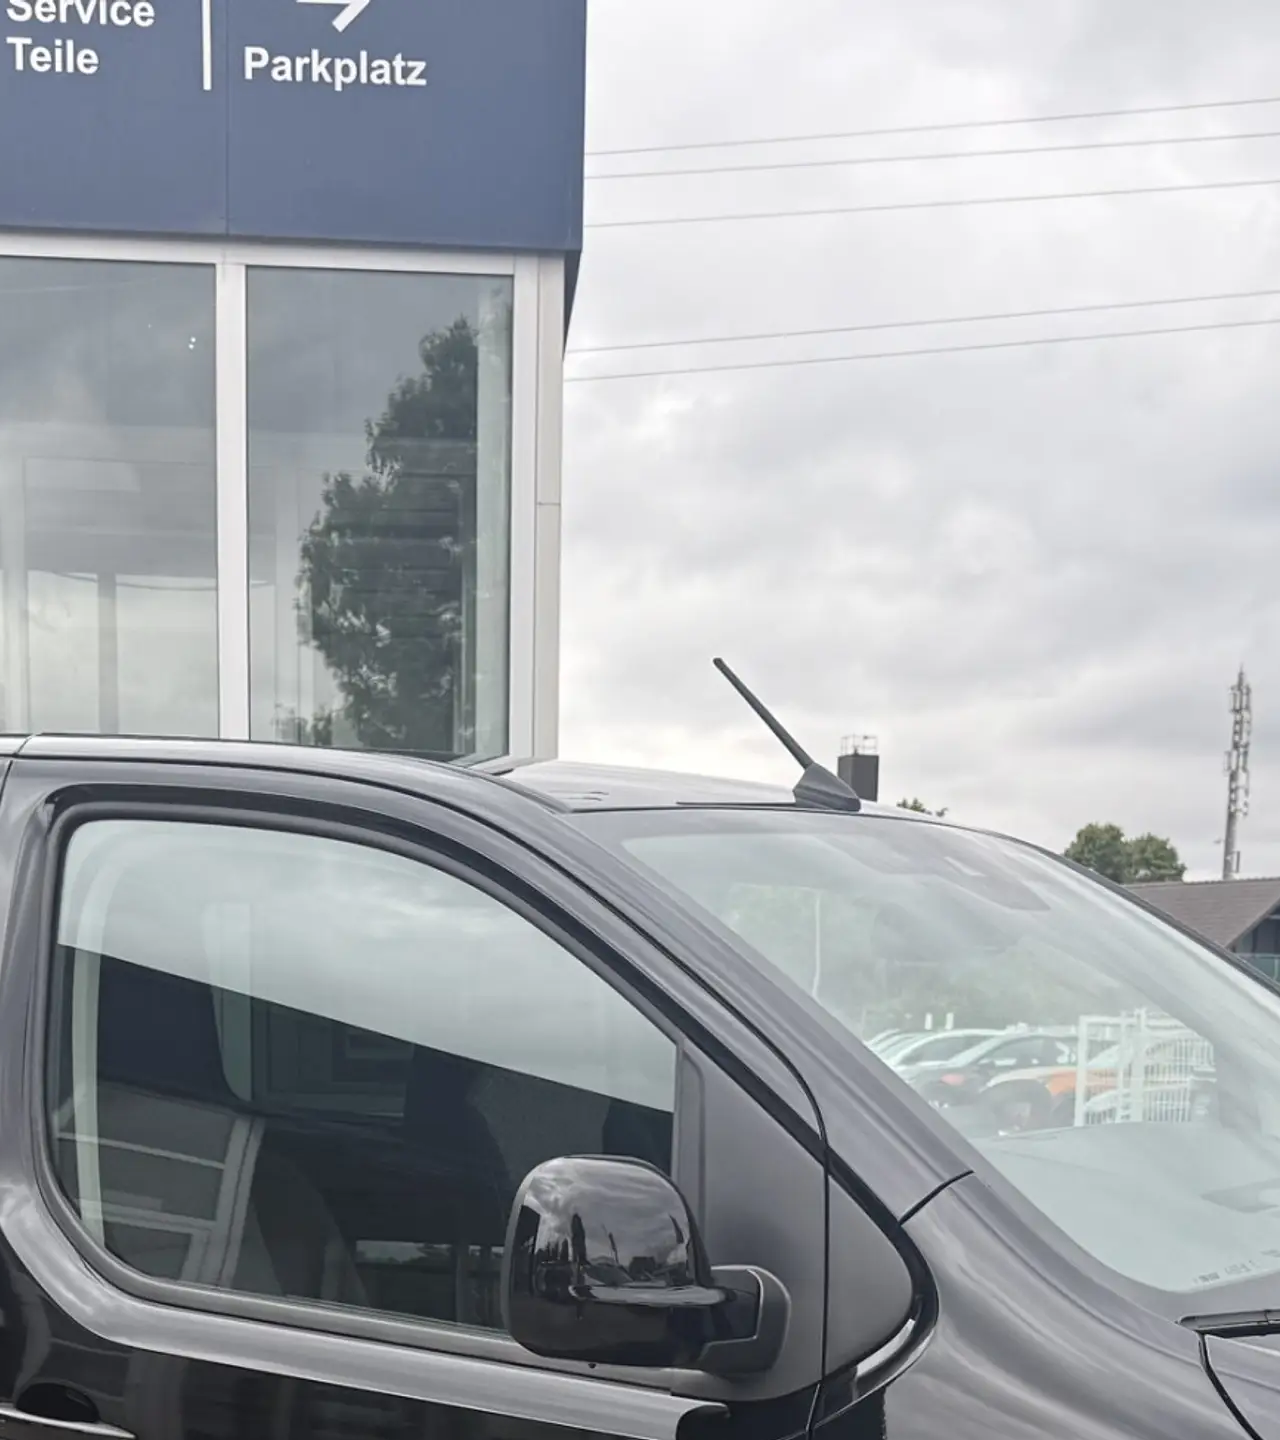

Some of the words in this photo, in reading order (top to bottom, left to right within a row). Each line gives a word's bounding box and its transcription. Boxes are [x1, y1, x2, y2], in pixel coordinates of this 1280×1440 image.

[6, 0, 156, 27] Service
[6, 36, 100, 74] Teile
[243, 45, 428, 92] Parkplatz
